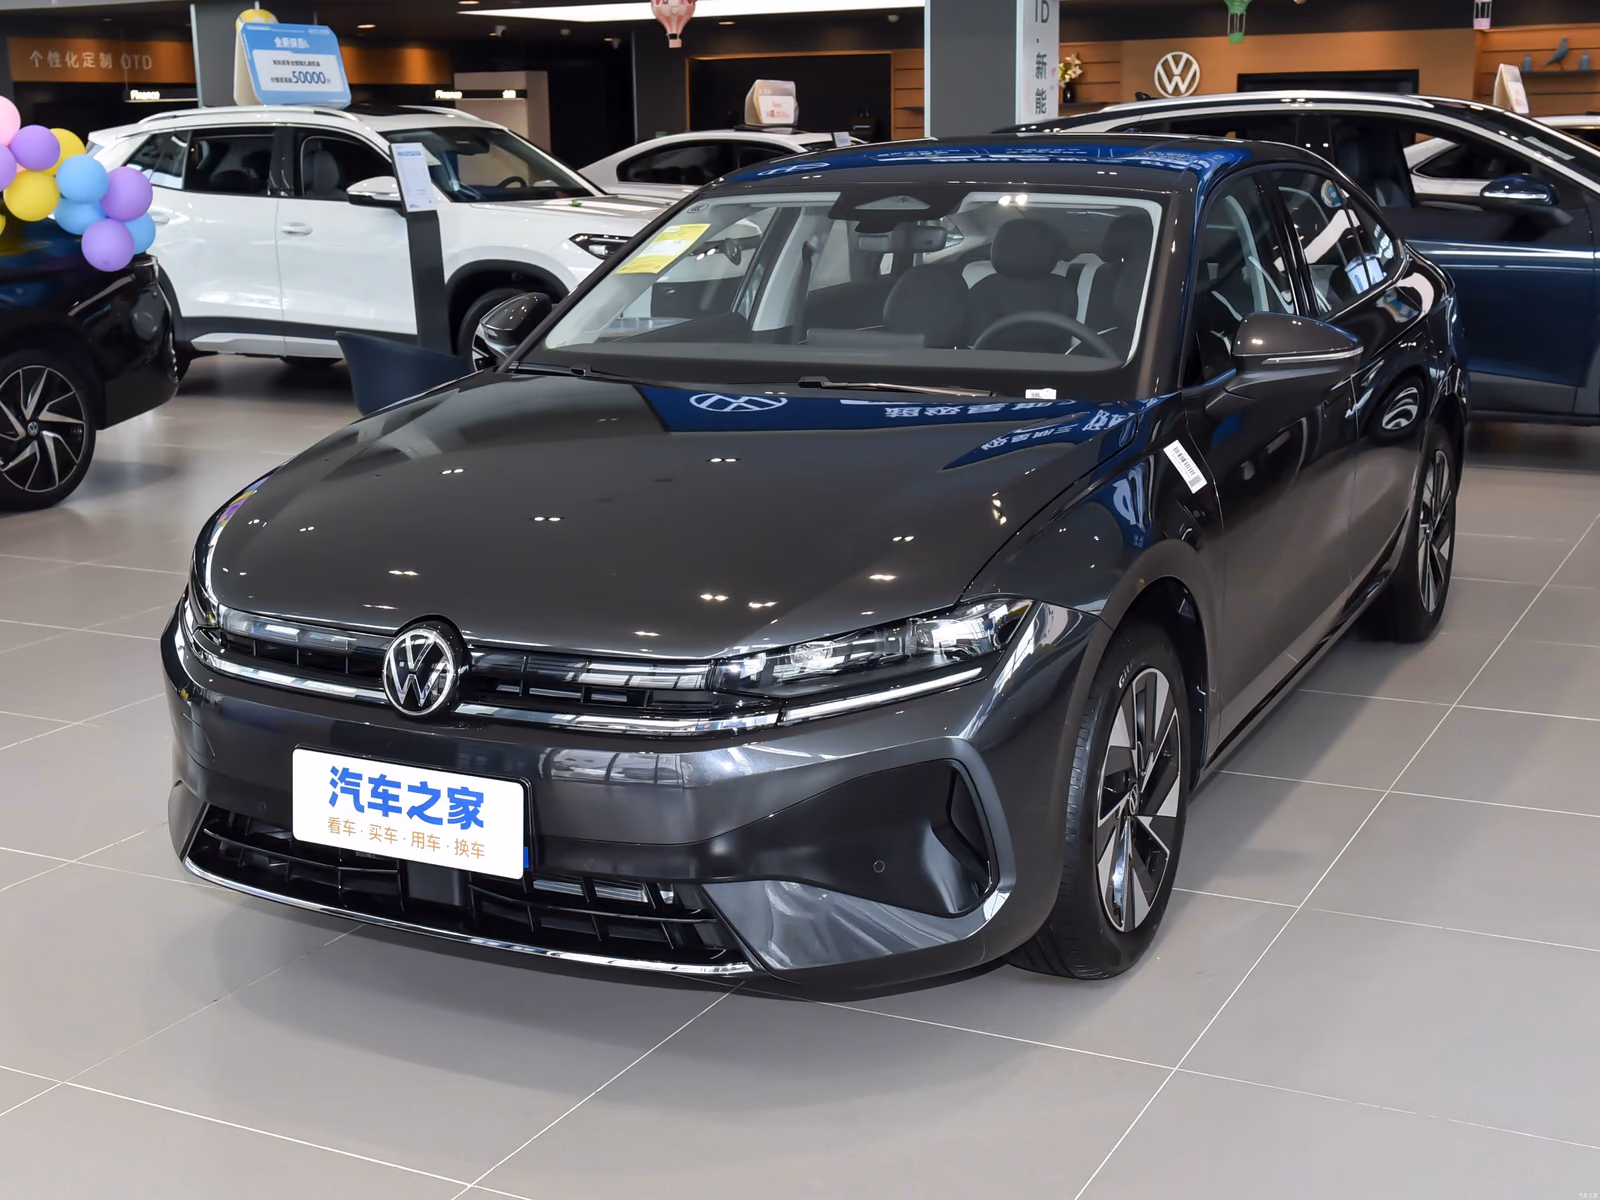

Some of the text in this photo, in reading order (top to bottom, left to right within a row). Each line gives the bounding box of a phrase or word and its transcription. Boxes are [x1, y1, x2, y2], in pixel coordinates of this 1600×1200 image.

[29, 50, 153, 70] 个性化定制 OTD
[328, 765, 485, 831] 汽车之家
